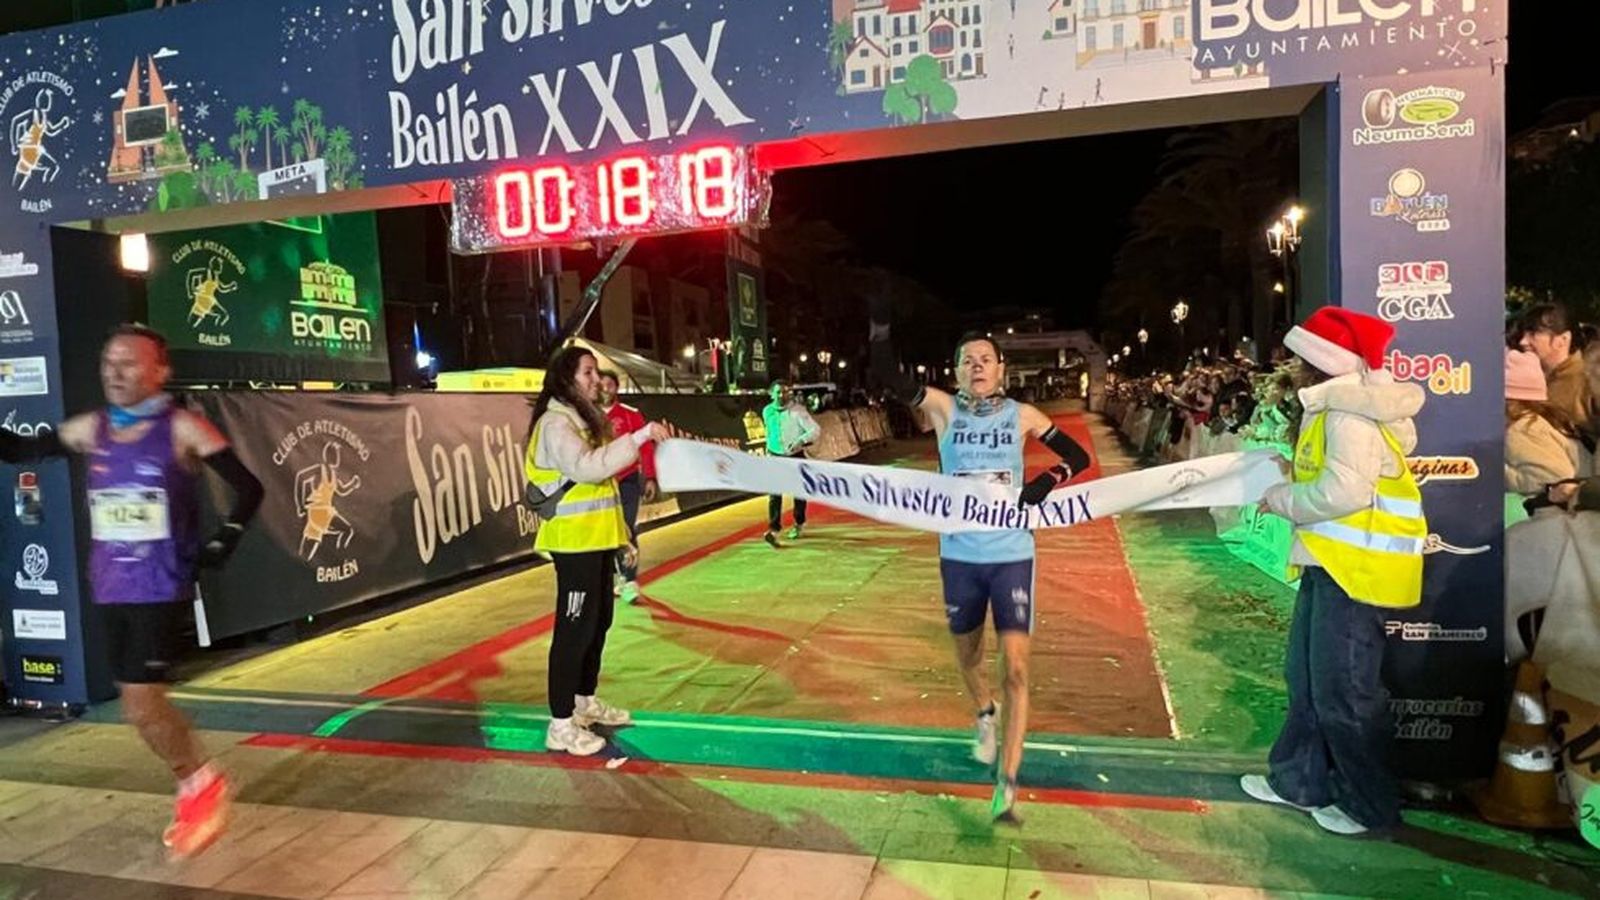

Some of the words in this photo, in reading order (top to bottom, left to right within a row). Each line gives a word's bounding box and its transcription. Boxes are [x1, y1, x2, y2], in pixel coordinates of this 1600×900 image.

[1201, 19, 1476, 63] AYUNTAMIENTO
[26, 71, 74, 96] ATLETISMO
[388, 83, 518, 168] Bailén
[528, 19, 755, 156] XXIX
[1353, 120, 1474, 145] NeumaServi
[275, 164, 306, 181] META
[204, 240, 246, 275] ATLETISMO
[1378, 294, 1454, 322] CGA
[1384, 349, 1452, 381] ban
[272, 431, 298, 465] CLUB
[297, 421, 313, 439] DE
[314, 420, 370, 461] ATLETISMO
[953, 429, 1012, 449] nerja
[405, 405, 482, 564] San
[1411, 459, 1469, 483] áginas
[798, 463, 850, 497] San
[861, 473, 952, 518] Silvestre
[962, 494, 1030, 530] Bailén
[1036, 491, 1093, 528] XXIX
[316, 558, 359, 582] BAILÉN
